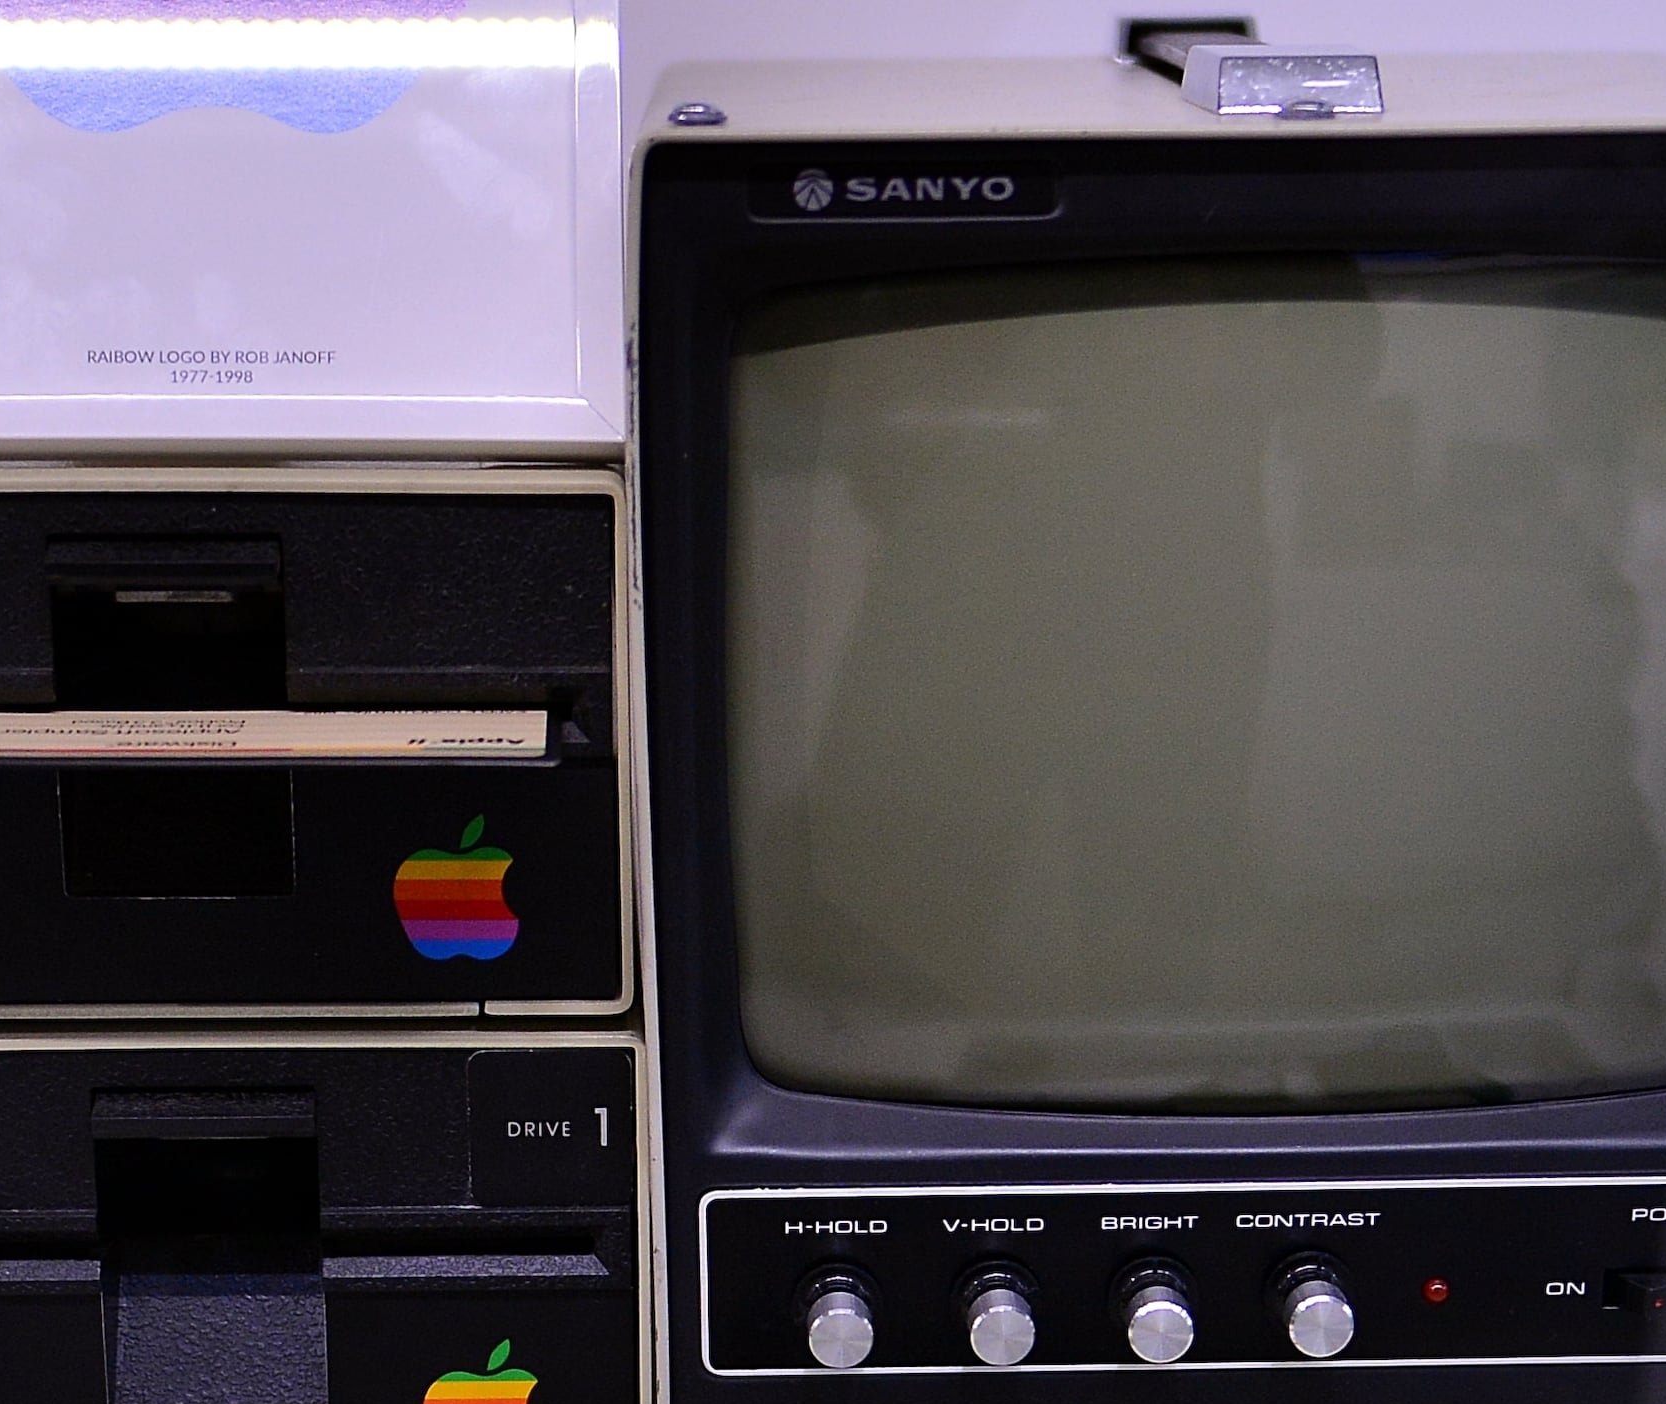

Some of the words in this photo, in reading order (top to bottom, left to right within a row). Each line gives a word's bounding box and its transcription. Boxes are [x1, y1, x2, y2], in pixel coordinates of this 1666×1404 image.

[845, 175, 1015, 202] SANYO
[87, 350, 154, 364] RAIBOW
[159, 350, 206, 364] LOGO
[210, 350, 231, 364] BY
[235, 350, 270, 364] ROB
[273, 350, 336, 365] JANOFF
[170, 370, 253, 384] 1977-1998
[507, 1121, 571, 1138] DRIVE
[594, 1107, 608, 1147] 1
[784, 1219, 888, 1234] H-HOLD
[942, 1218, 1045, 1233] V-HOLD
[1100, 1215, 1200, 1231] BRIGHT
[1235, 1212, 1382, 1229] CONTRAST
[1545, 1281, 1586, 1296] ON
